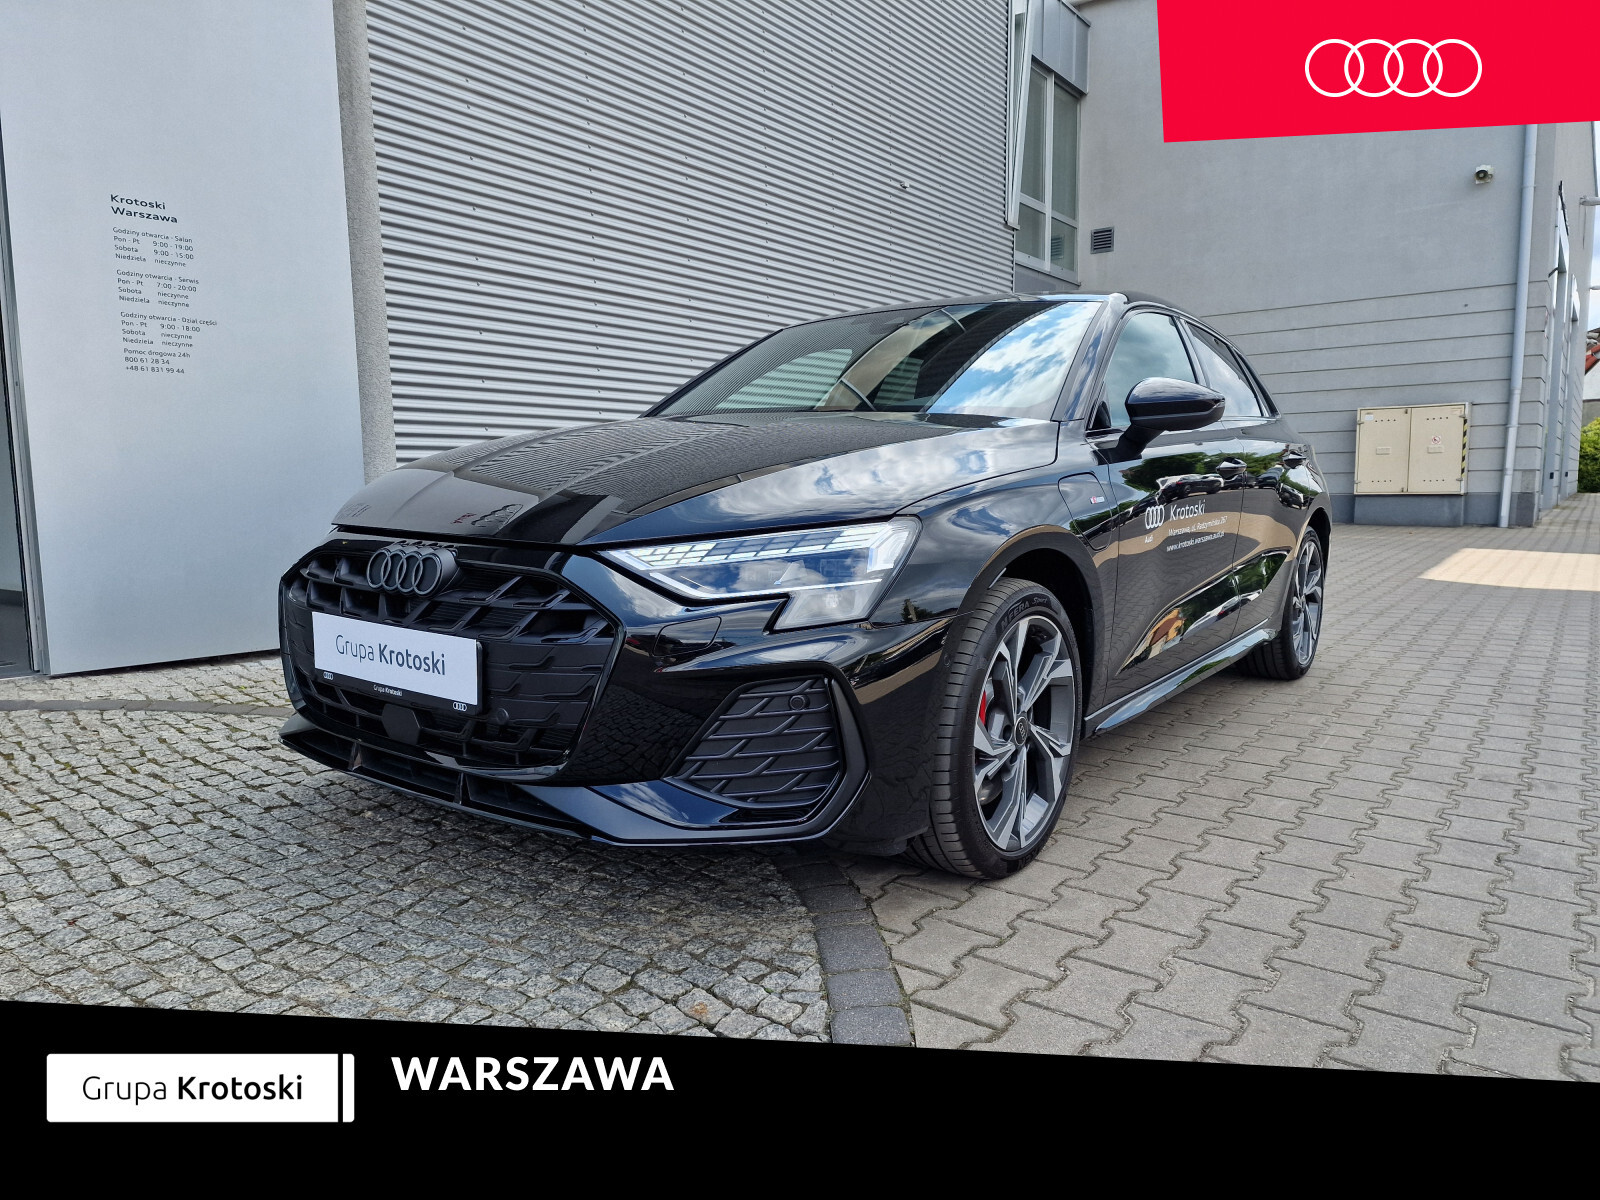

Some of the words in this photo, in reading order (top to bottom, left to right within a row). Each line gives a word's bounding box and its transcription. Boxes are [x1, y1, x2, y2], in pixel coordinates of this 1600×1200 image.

[110, 194, 166, 210] Krotoski
[111, 206, 178, 224] Warszawa
[112, 226, 140, 237] Godziny
[141, 231, 170, 240] otwarcia
[174, 236, 193, 244] Salon
[114, 244, 138, 253] Sobota
[154, 249, 170, 257] 9:00
[176, 252, 194, 260] 15:00
[174, 244, 194, 252] 19:00
[115, 253, 147, 262] Niedziela
[154, 258, 187, 268] nieczynne
[116, 269, 144, 279] Godziny
[144, 273, 173, 281] otwarcia
[178, 276, 200, 284] Serwis
[118, 286, 142, 294] Sobota
[157, 291, 189, 300] nieczynne
[156, 282, 172, 290] 7:00
[178, 284, 197, 292] 20:00
[118, 295, 150, 304] Niedziela
[158, 300, 190, 308] nieczynne
[120, 311, 148, 320] Godziny
[148, 314, 176, 322] otwarcia
[121, 328, 146, 336] Sobota
[160, 332, 193, 340] nieczynne
[122, 336, 154, 346] Niedziela
[161, 340, 194, 349] nieczynne
[123, 348, 146, 356] Pomoc
[147, 350, 177, 358] drogowa
[1170, 499, 1206, 522] Krotoski
[1144, 534, 1154, 544] Audi
[336, 634, 374, 663] Grupa
[378, 643, 446, 676] Krotoski
[373, 684, 385, 693] Grupa
[385, 687, 402, 696] Krotoski
